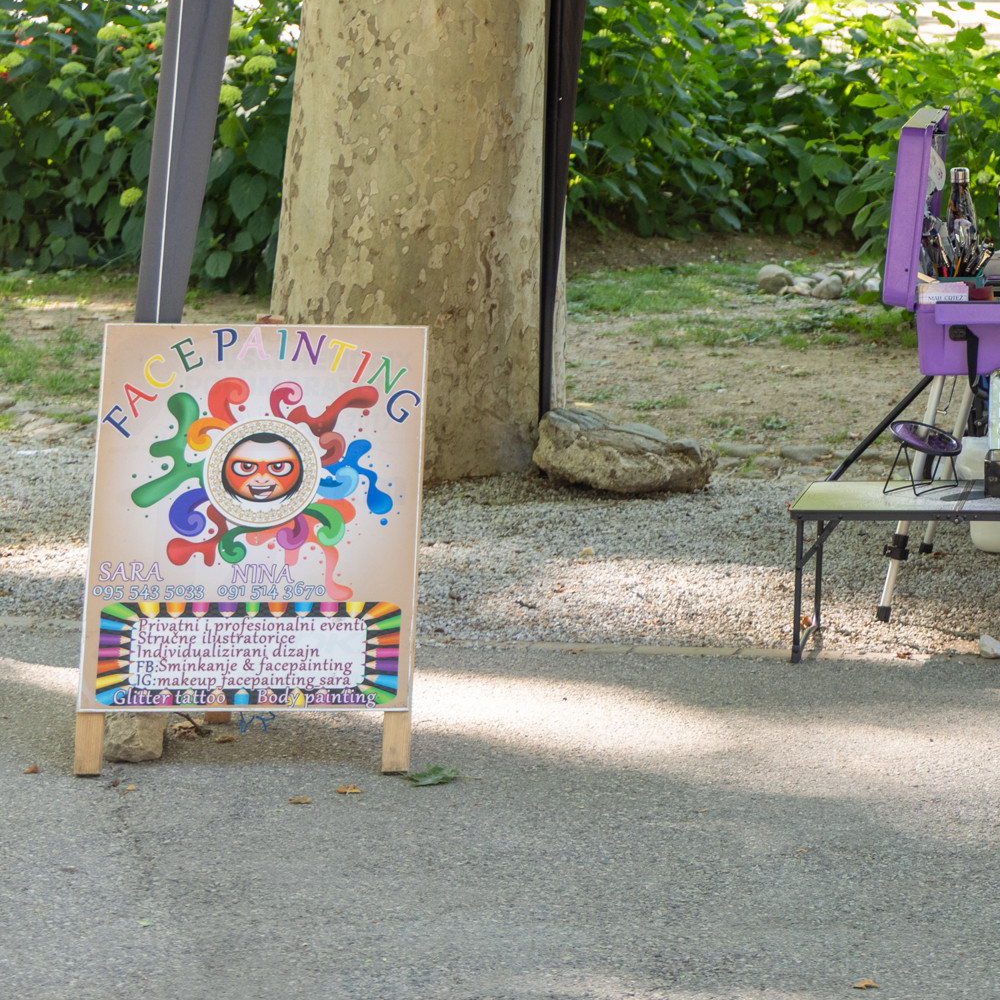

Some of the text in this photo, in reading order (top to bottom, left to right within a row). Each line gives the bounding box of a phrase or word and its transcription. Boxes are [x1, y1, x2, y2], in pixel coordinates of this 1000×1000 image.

[98, 561, 164, 582] SARA
[231, 563, 294, 584] NINA
[92, 584, 204, 600] 095 543 5033
[217, 581, 325, 600] 091 514 3670
[138, 616, 366, 636] Privatni i profesionalni eventi
[137, 629, 296, 644] Stručne ilustratorice
[137, 642, 320, 661] Individualizirani dizajn
[242, 658, 255, 672] &
[255, 656, 353, 676] facepainting
[113, 687, 226, 706] Glitter tattoo
[257, 686, 377, 709] Body painting
